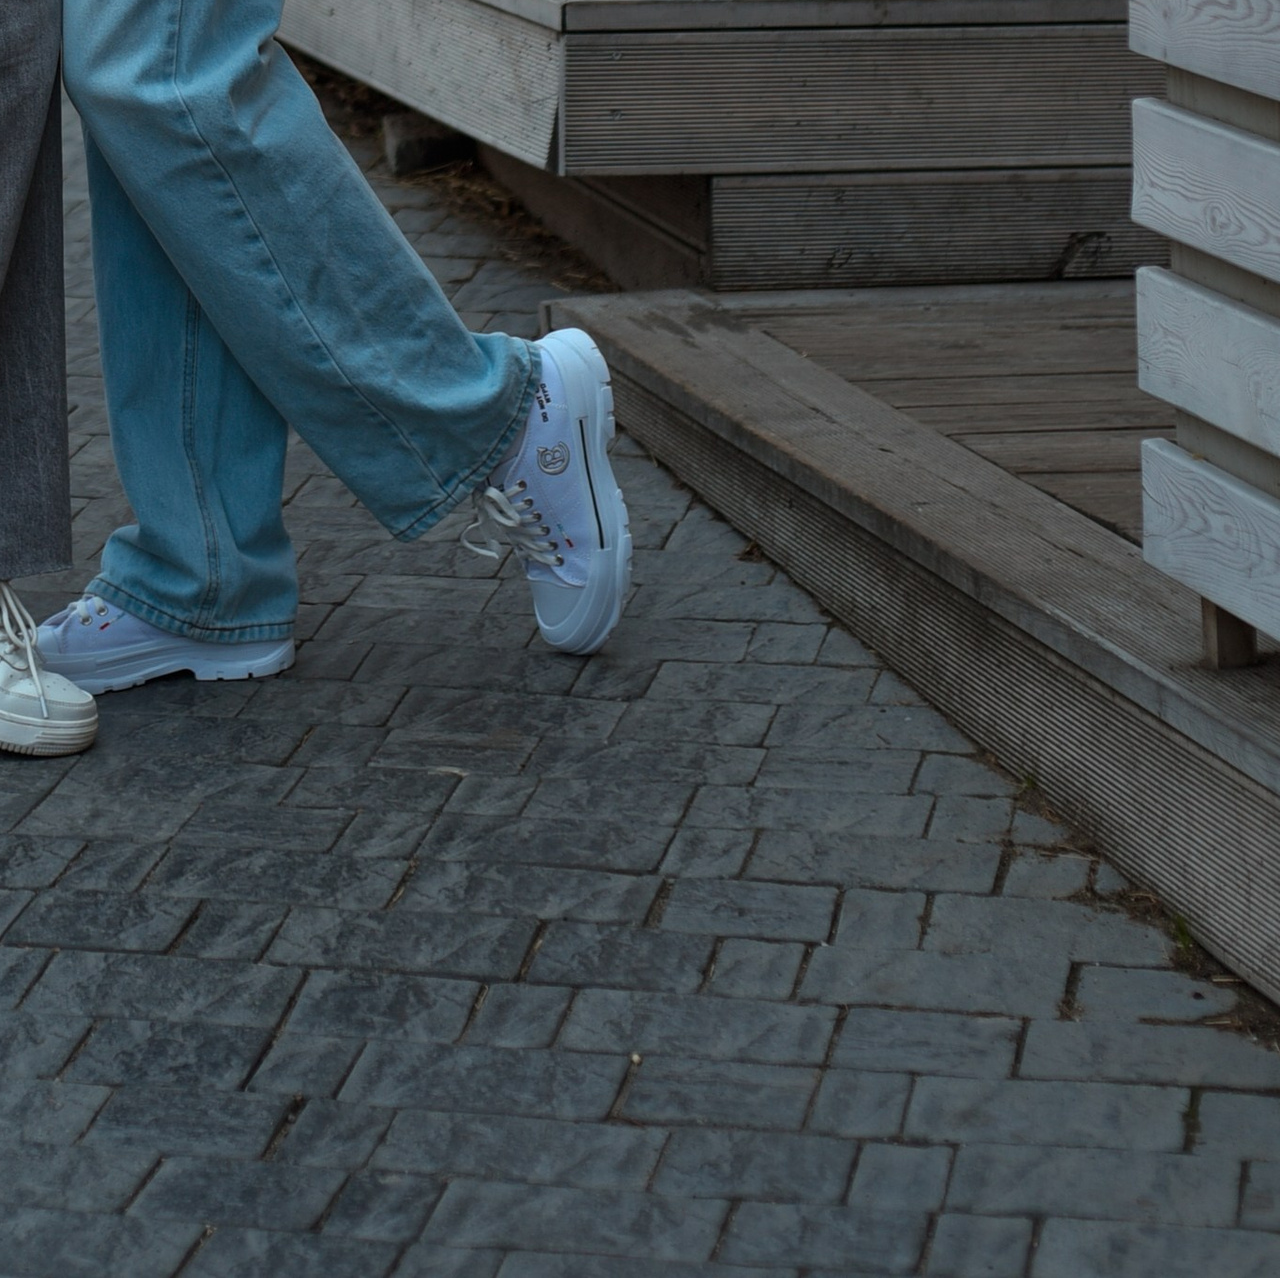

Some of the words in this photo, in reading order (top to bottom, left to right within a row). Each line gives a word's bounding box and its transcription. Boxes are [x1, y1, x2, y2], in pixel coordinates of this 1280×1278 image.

[540, 383, 551, 403] NYPD
[536, 395, 545, 410] NOT
[541, 411, 549, 423] DO
